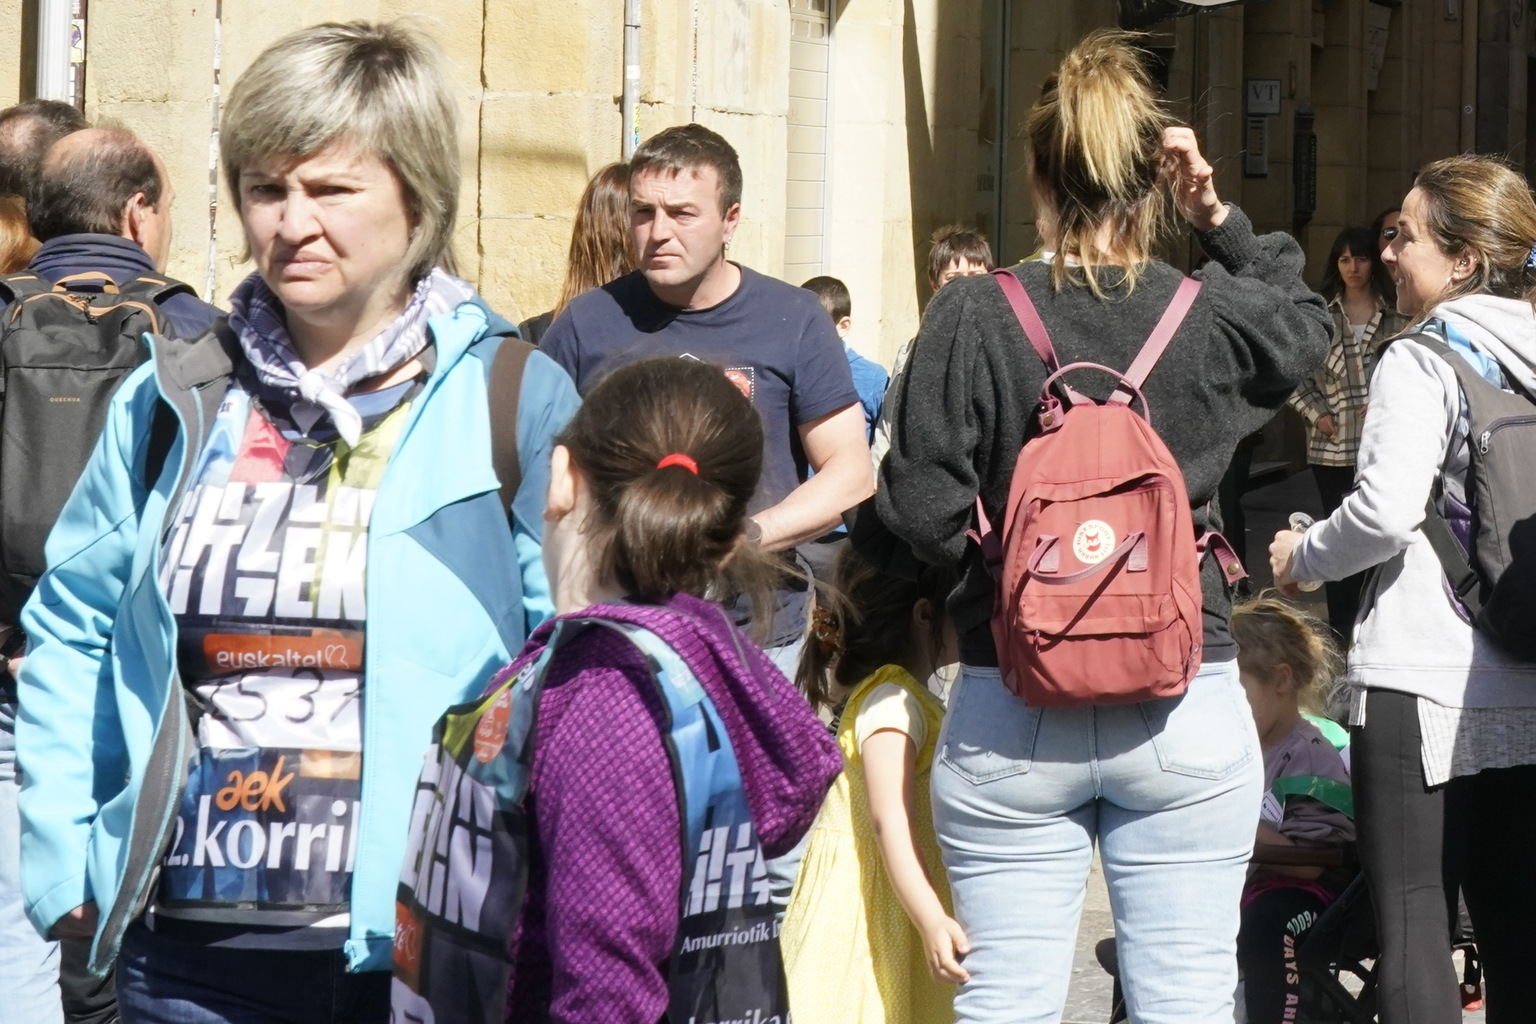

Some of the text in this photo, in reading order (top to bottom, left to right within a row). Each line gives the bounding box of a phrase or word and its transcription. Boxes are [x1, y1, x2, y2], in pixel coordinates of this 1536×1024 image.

[1252, 84, 1278, 101] VT
[217, 648, 323, 669] euskaltel
[216, 755, 294, 813] aek
[680, 921, 769, 955] Amurriotik
